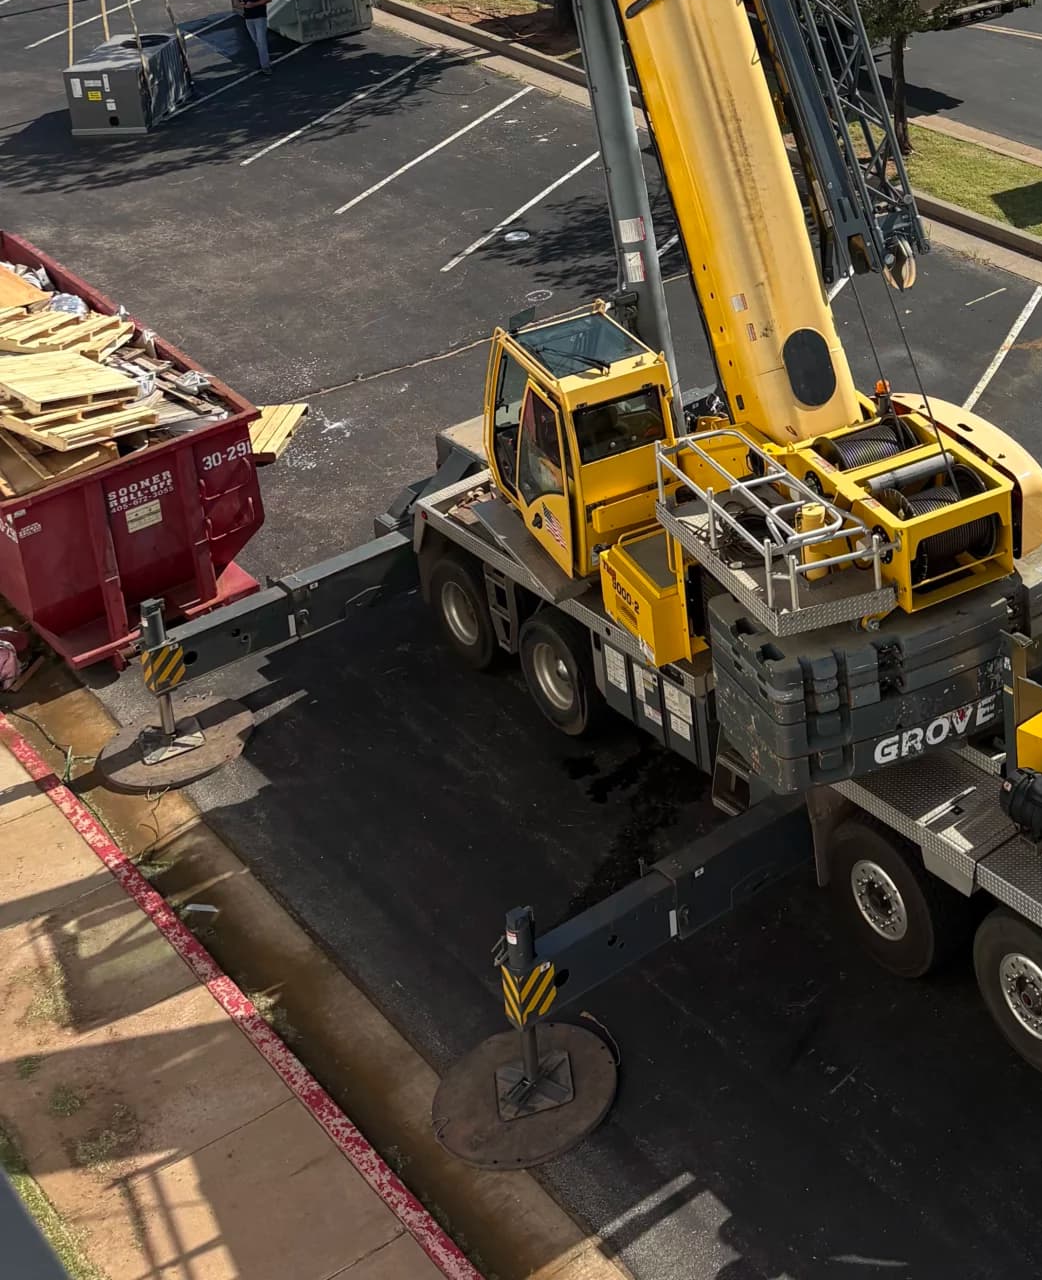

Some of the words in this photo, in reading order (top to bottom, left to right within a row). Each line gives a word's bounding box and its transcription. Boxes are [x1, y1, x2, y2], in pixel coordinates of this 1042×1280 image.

[108, 470, 172, 500] SOONER
[109, 478, 173, 508] ROLL-OFF
[874, 694, 998, 765] GROVE
